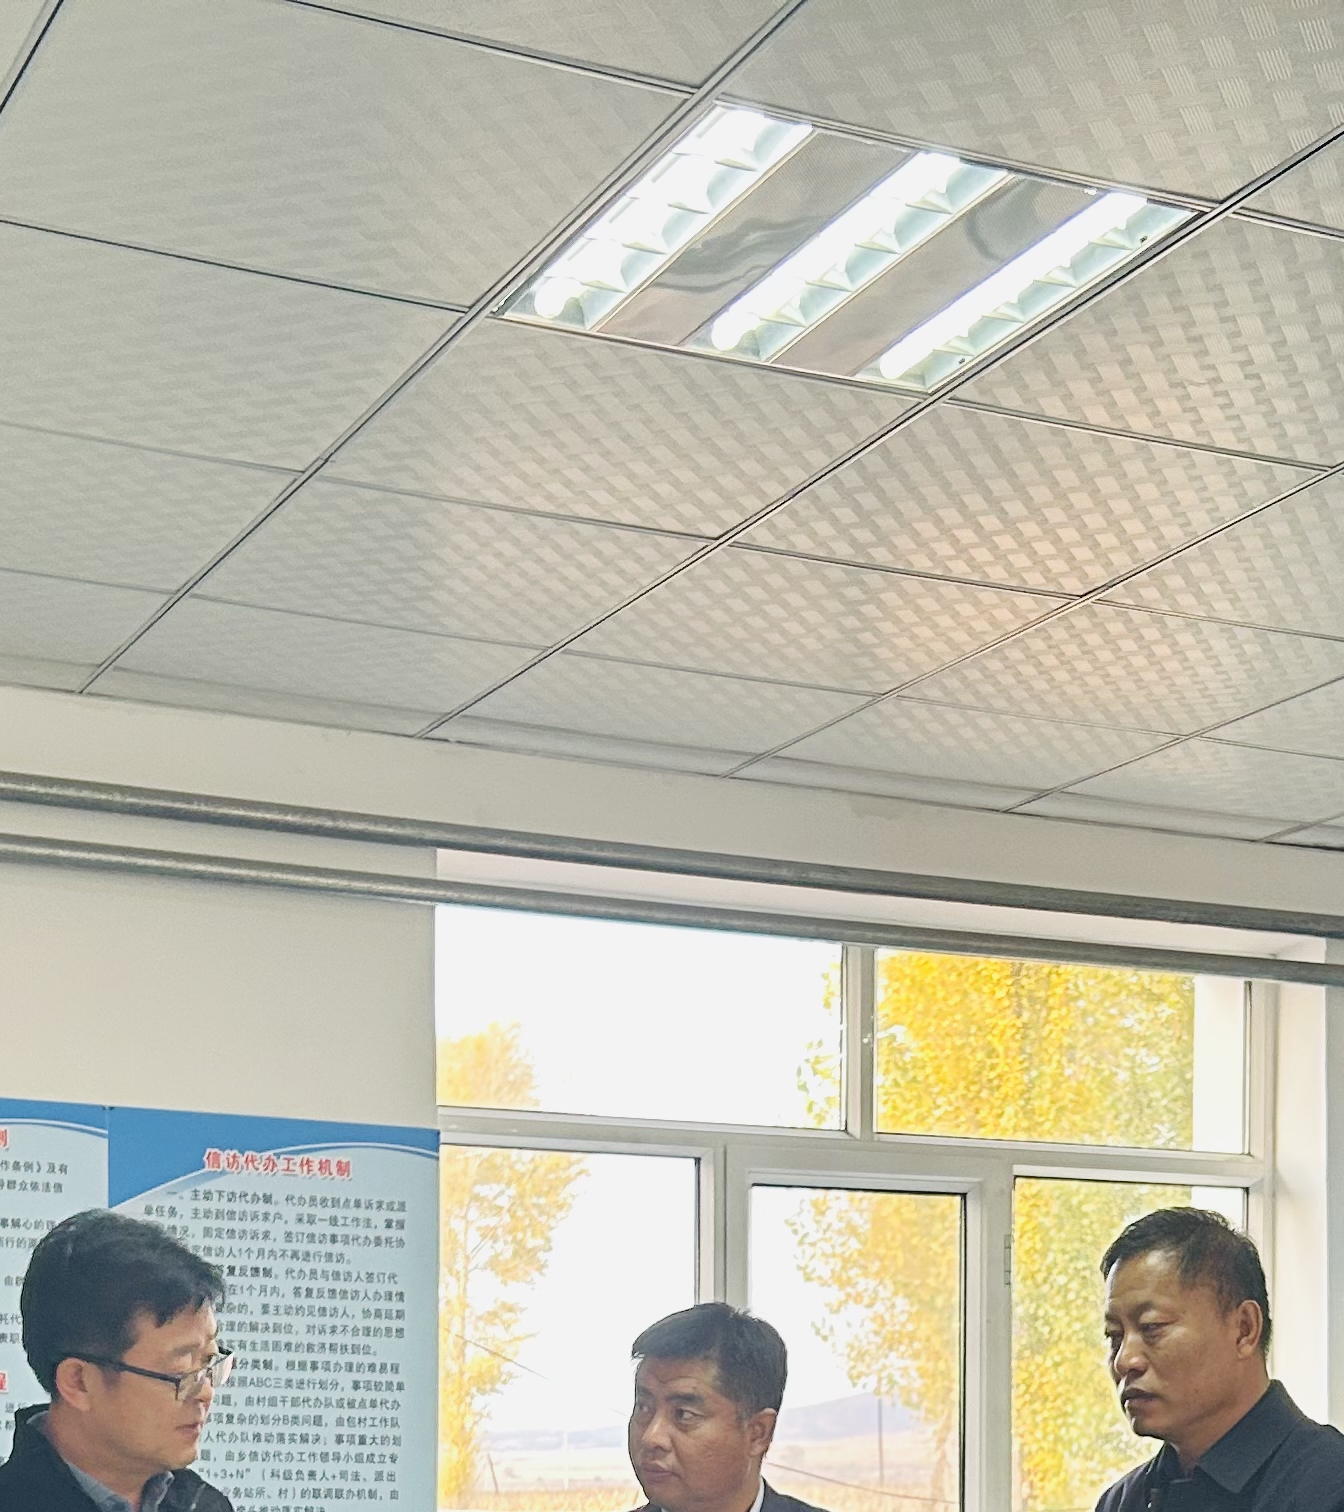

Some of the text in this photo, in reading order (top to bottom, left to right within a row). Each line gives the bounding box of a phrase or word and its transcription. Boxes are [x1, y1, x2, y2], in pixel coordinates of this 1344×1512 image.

[205, 1151, 351, 1178] 信访代办工作机制
[196, 1450, 399, 1465] 题，由乡信访代办工作领导小组成立专
